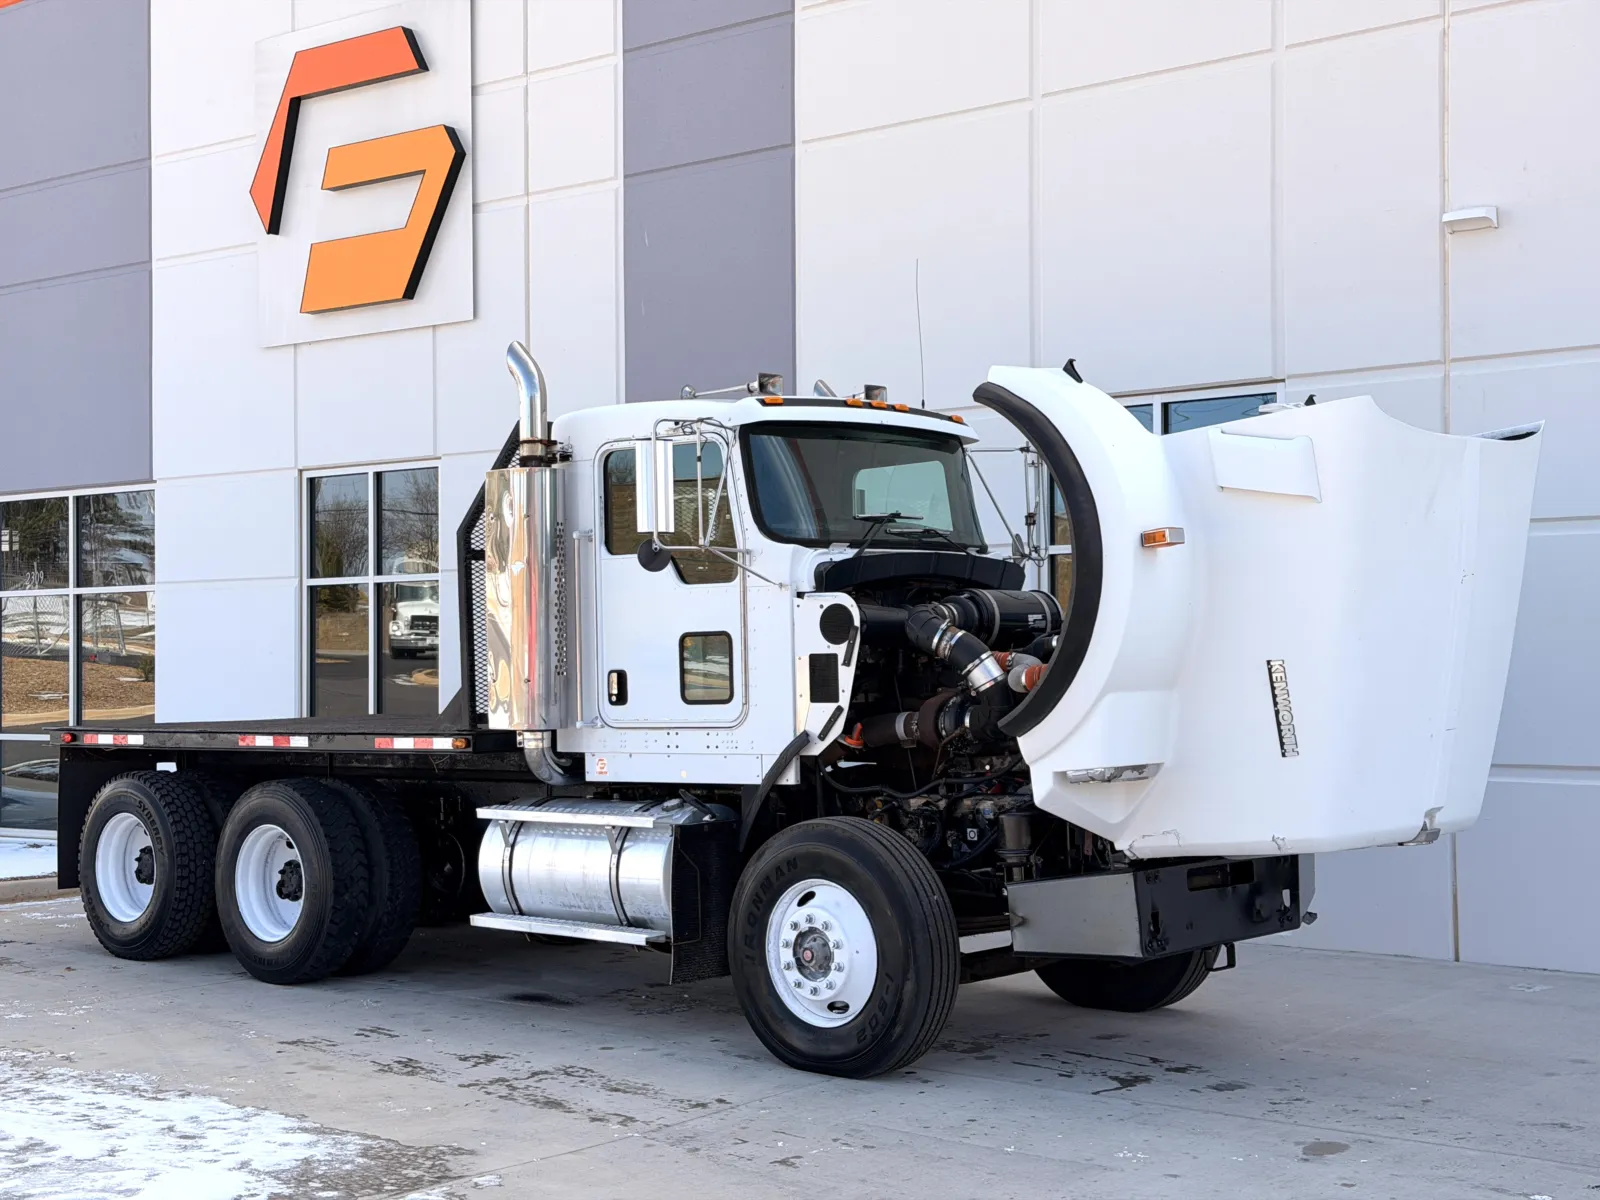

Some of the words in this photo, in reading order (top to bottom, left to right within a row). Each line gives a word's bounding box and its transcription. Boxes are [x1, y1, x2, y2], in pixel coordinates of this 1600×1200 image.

[25, 571, 44, 585] 2309
[1268, 660, 1299, 758] KENWORTH
[136, 800, 166, 856] SYNERGY
[744, 857, 799, 964] IRONMAN
